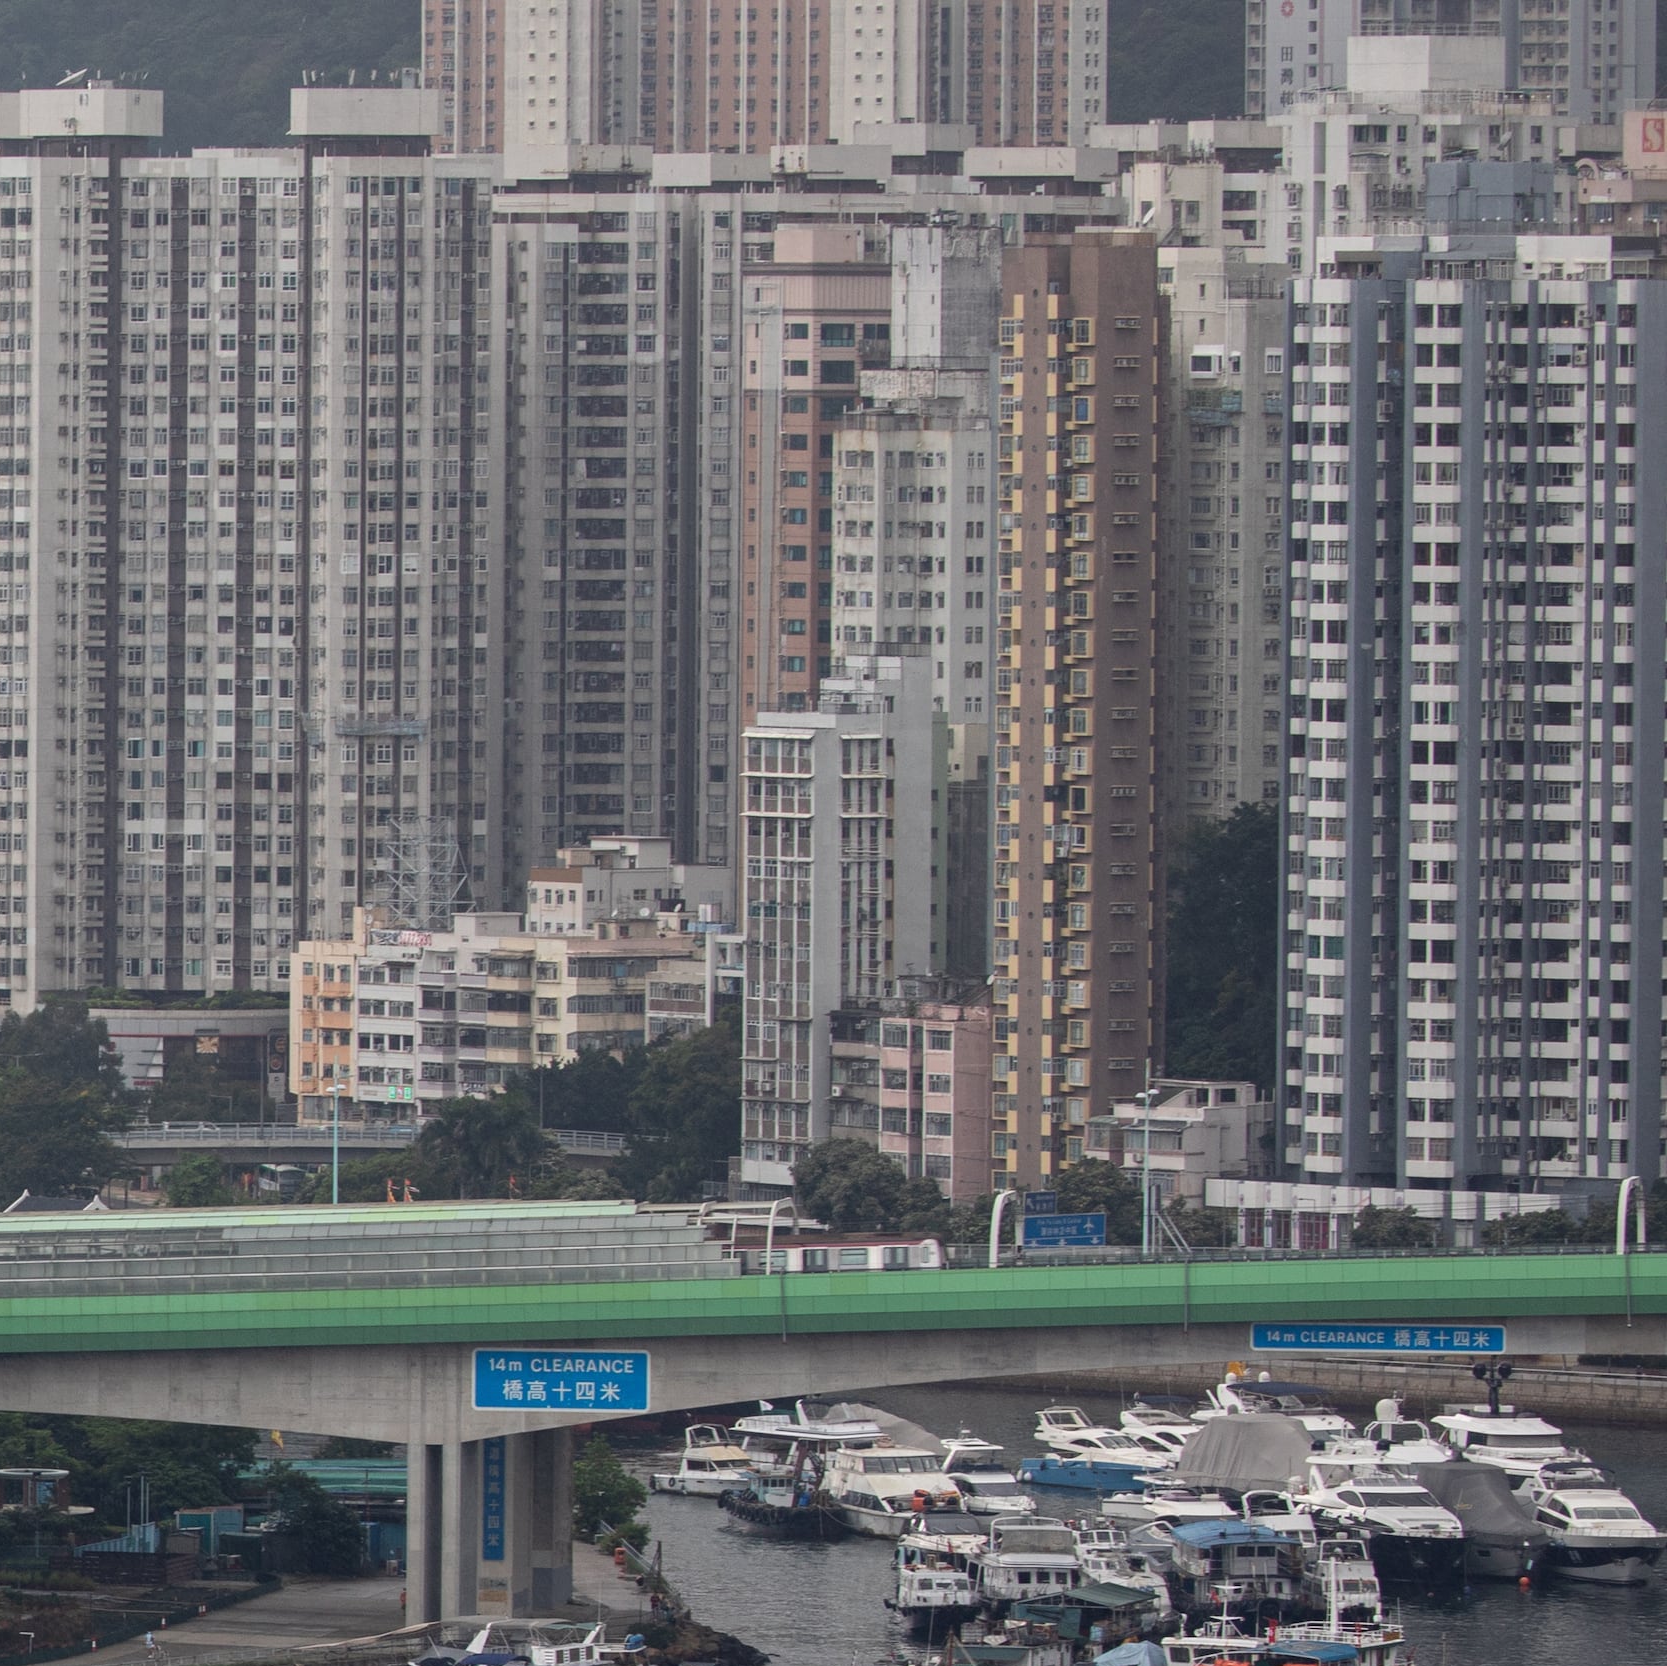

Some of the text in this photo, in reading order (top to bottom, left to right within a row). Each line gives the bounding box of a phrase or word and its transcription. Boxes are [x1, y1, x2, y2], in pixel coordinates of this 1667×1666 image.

[1300, 1331, 1385, 1344] CLEARANCE
[1394, 1330, 1490, 1347] 橋高十四米
[530, 1358, 634, 1374] CLEARANCE
[502, 1379, 621, 1403] 橋高十四米
